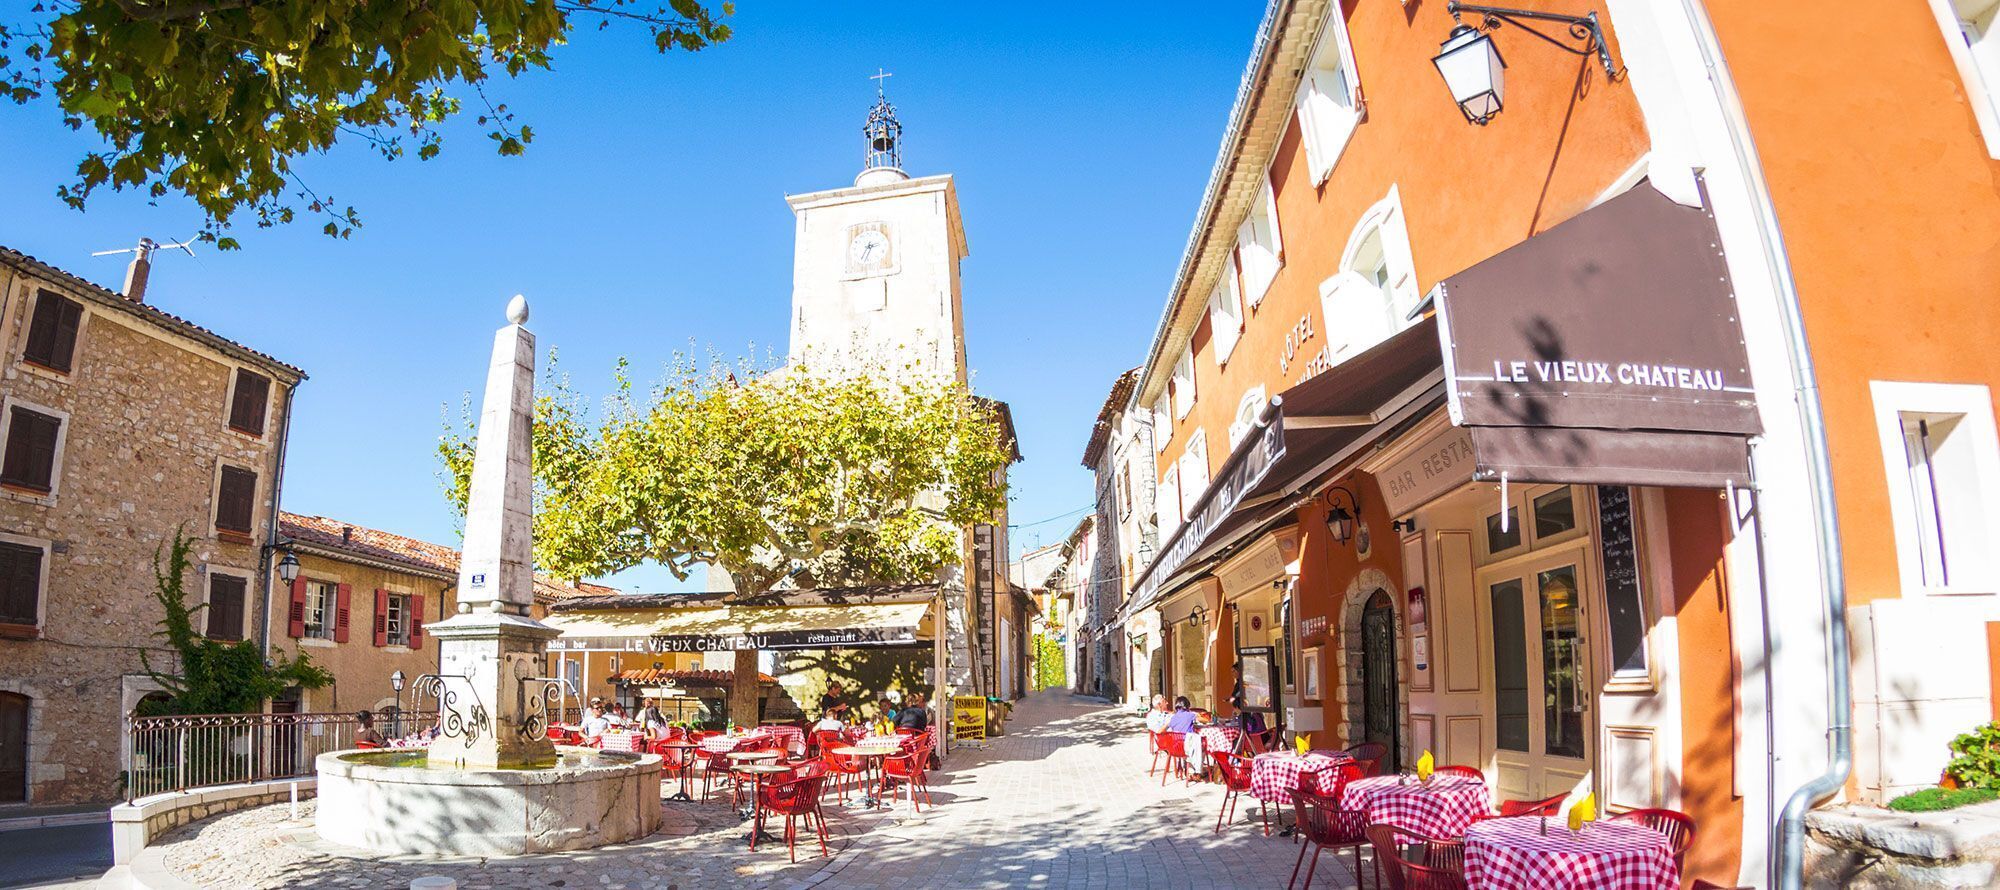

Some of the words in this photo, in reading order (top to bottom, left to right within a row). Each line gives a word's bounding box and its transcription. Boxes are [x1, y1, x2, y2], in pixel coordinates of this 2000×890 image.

[1493, 360, 1528, 383] LE
[1533, 361, 1613, 384] VIEUX
[1616, 363, 1724, 391] CHATEAU
[1389, 470, 1417, 498] BAR
[573, 640, 588, 649] bar
[625, 639, 645, 652] LE
[648, 637, 693, 652] VIEUX
[695, 636, 768, 652] CHATEAU
[808, 632, 856, 643] restaurant
